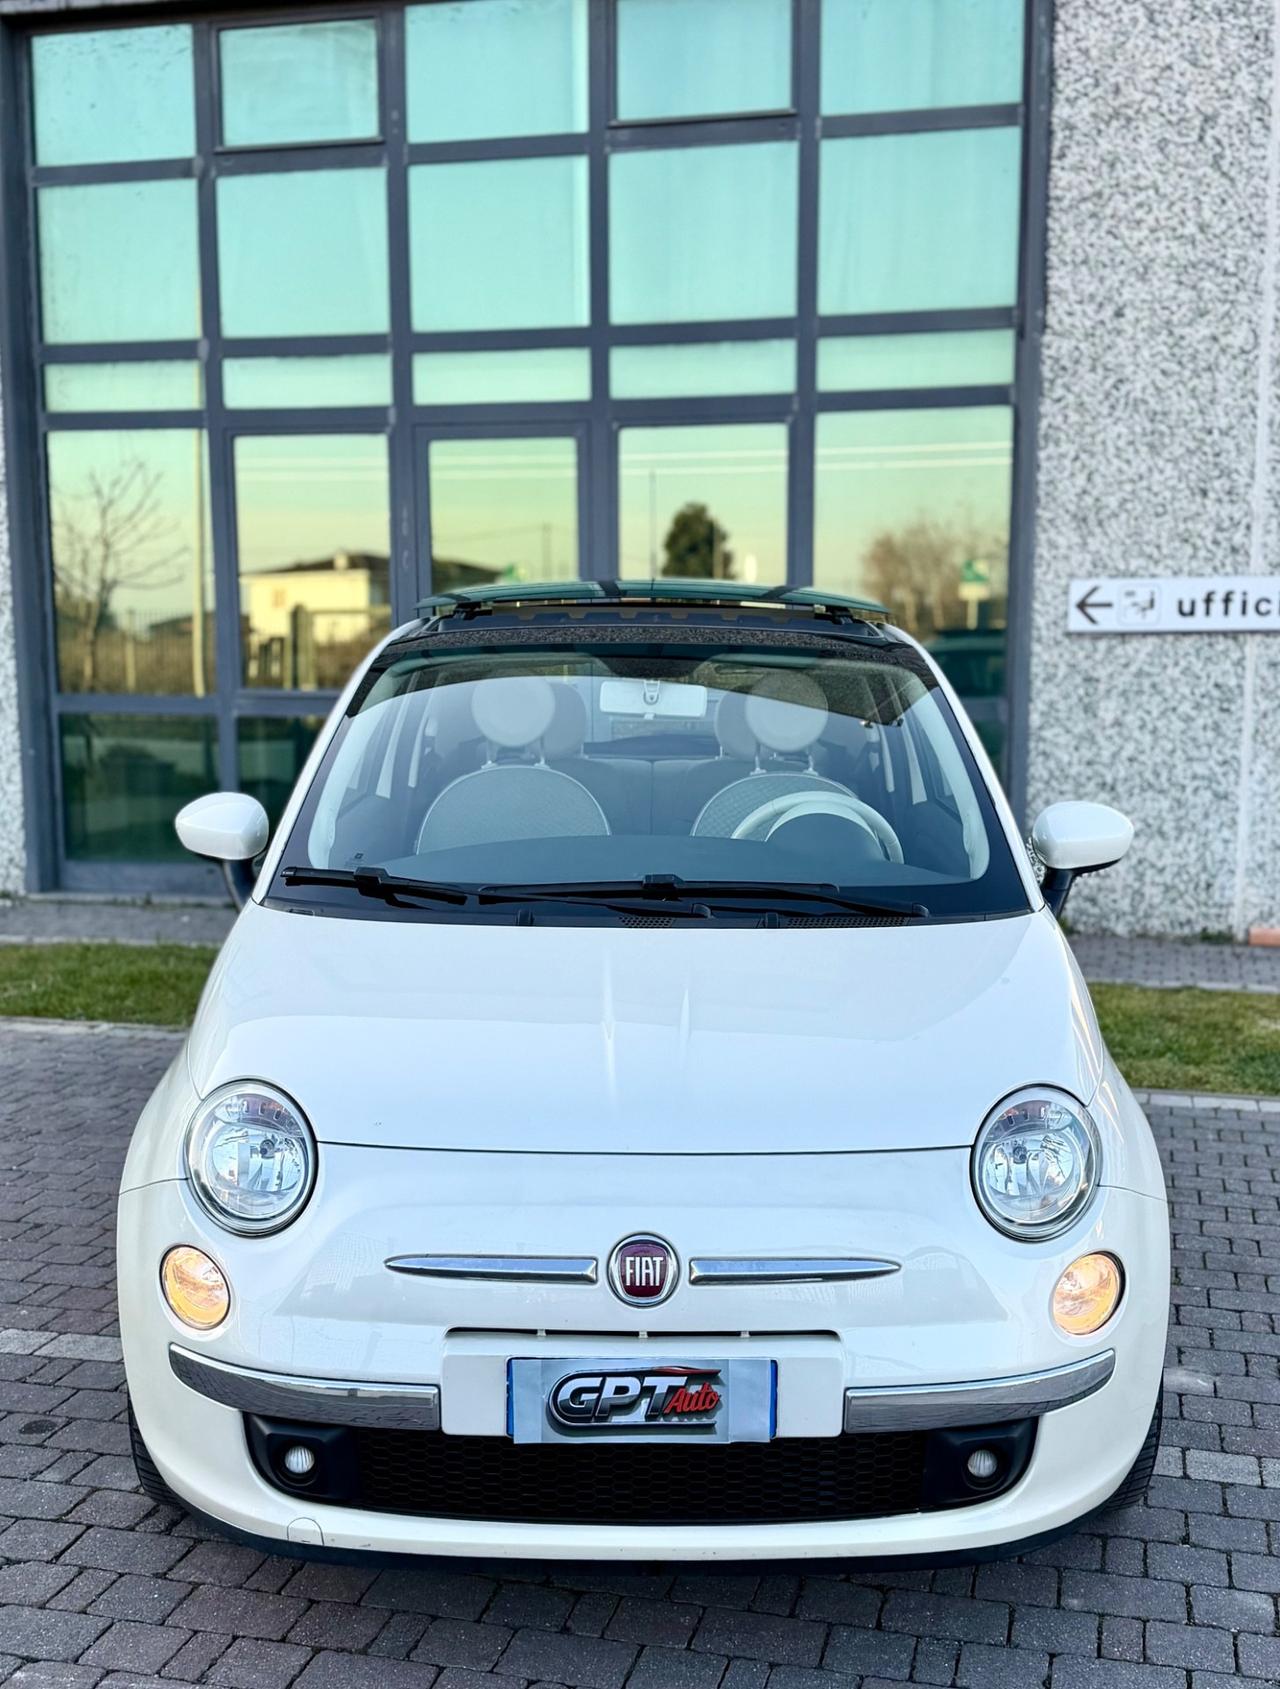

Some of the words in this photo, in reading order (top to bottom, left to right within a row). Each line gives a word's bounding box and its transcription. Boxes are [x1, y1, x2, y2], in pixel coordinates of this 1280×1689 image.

[625, 1256, 664, 1286] FIAT
[556, 1376, 688, 1416] GPT
[664, 1383, 719, 1414] Auto
